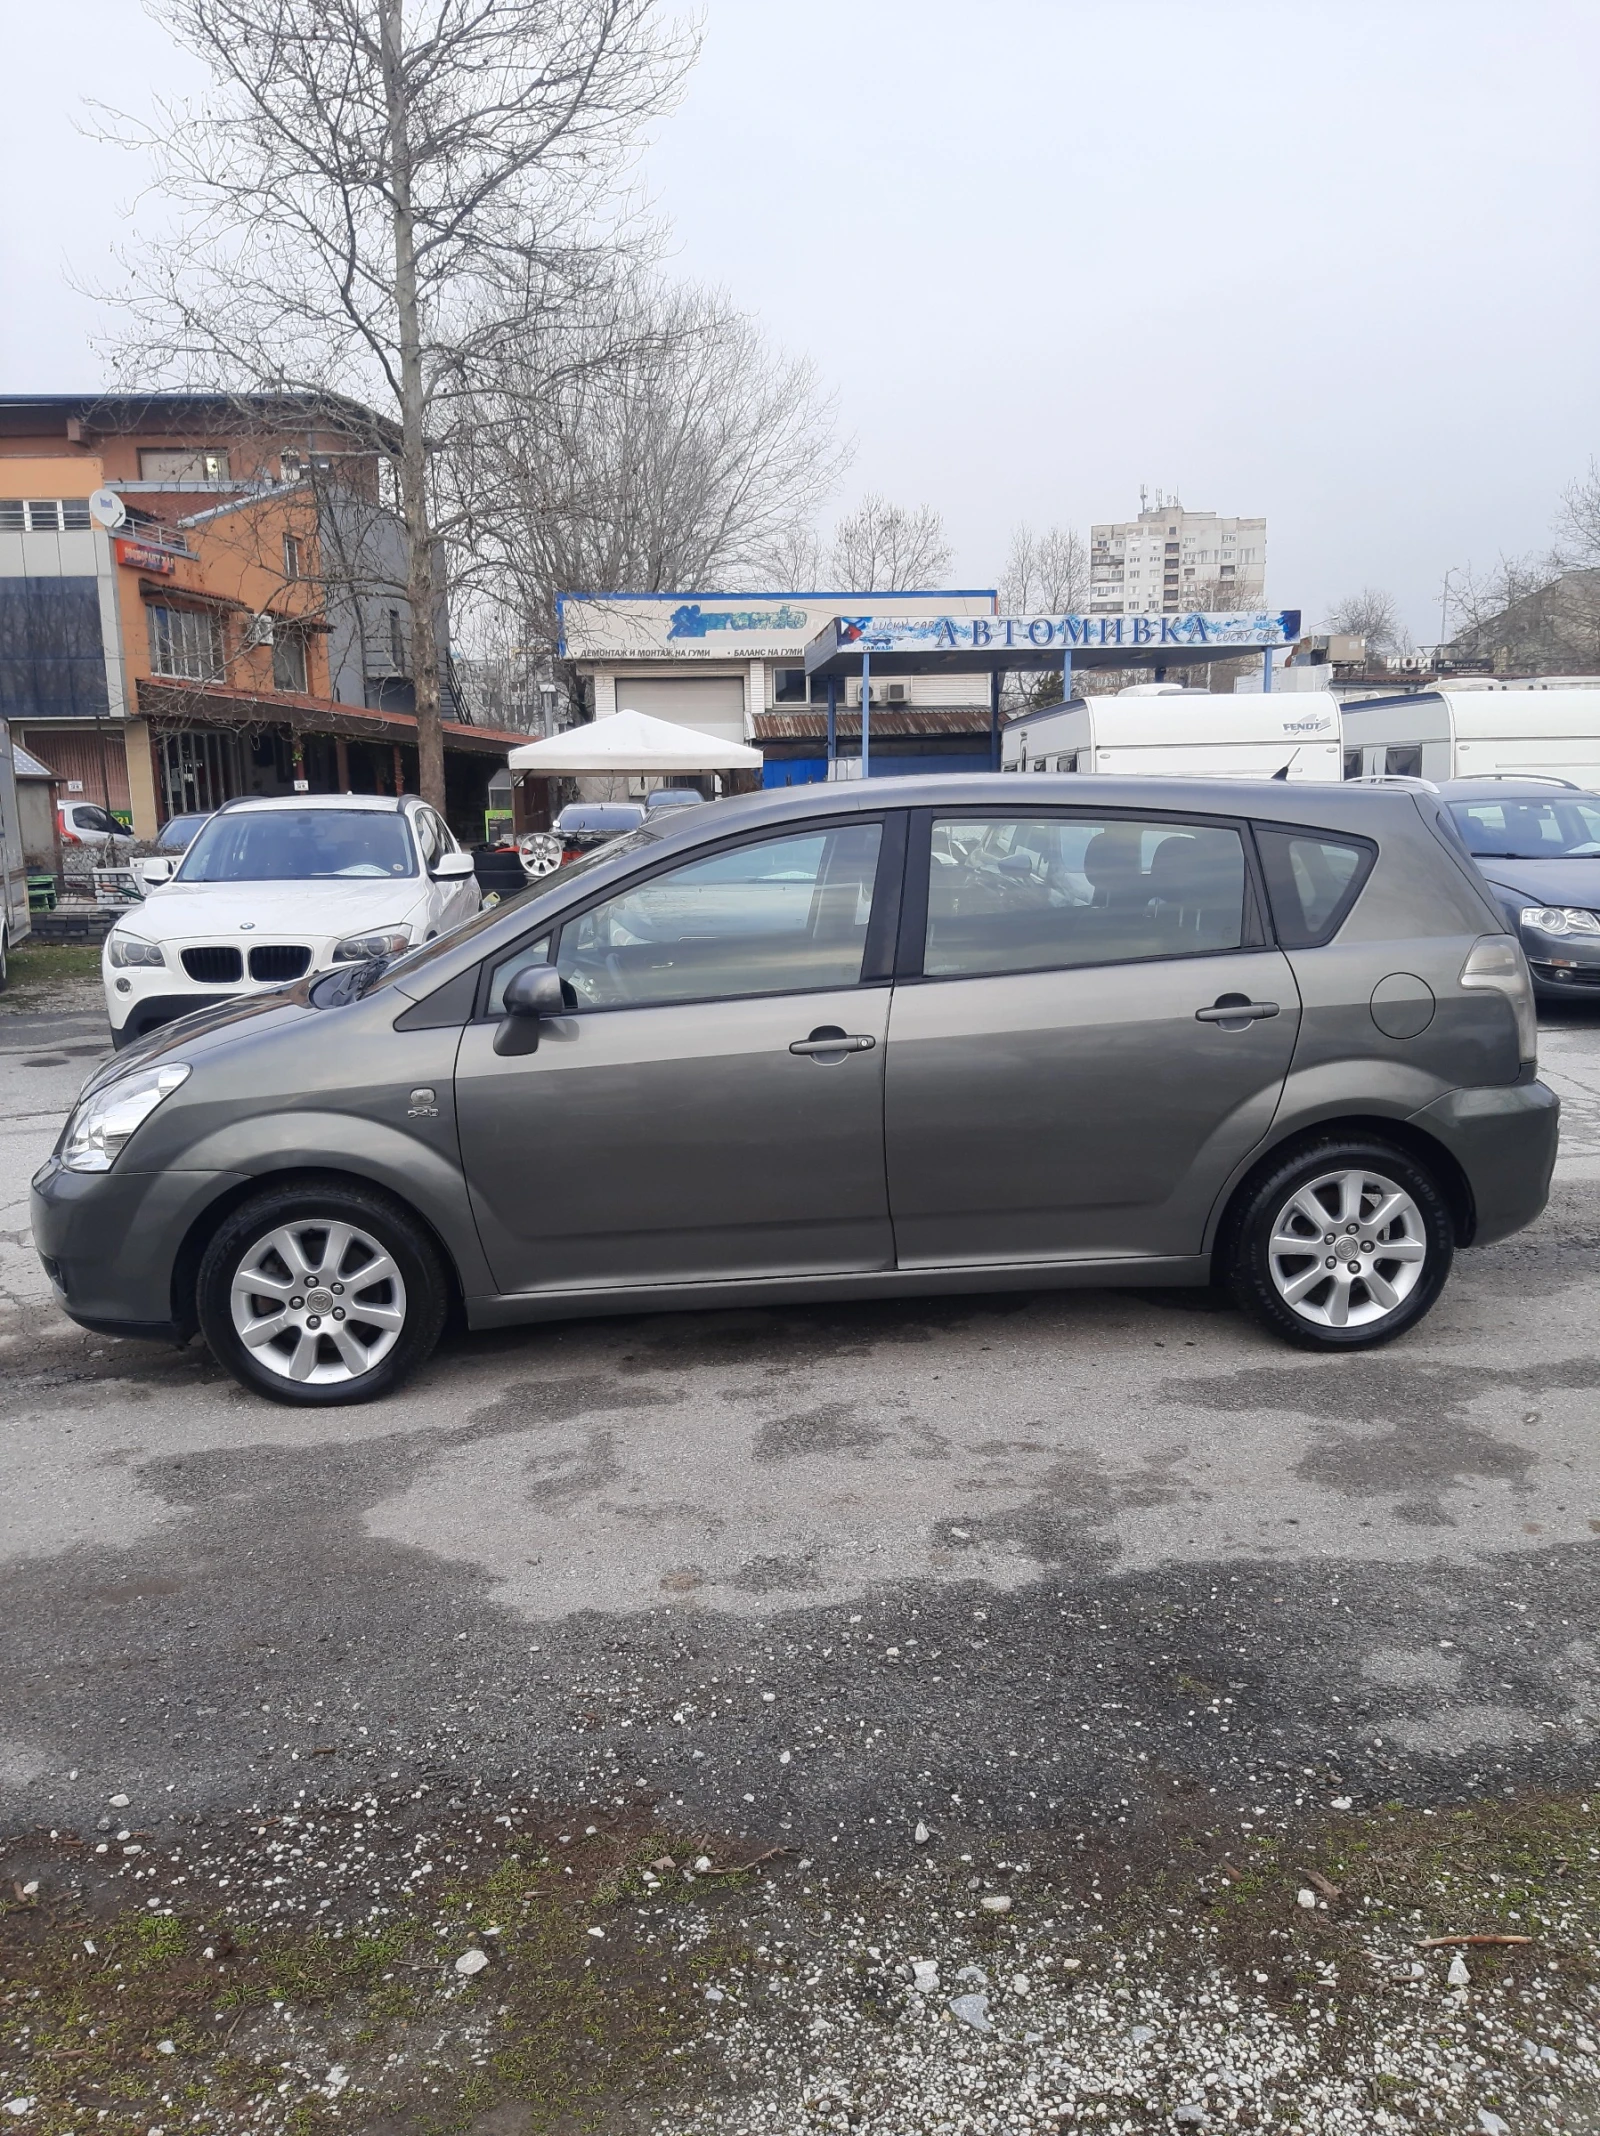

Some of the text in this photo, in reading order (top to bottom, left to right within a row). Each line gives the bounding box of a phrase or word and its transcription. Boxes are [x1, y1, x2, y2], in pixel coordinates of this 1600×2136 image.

[872, 620, 935, 632] LUCKY CAR
[934, 616, 1211, 647] АВТОМИВКА
[1256, 631, 1280, 643] CAR
[580, 649, 711, 658] ДЕМОНТАЖ И МОНТАЖ НА ГУМИ
[733, 647, 804, 657] БАЛАНС НА ГУМИ
[1282, 722, 1322, 731] FENDT
